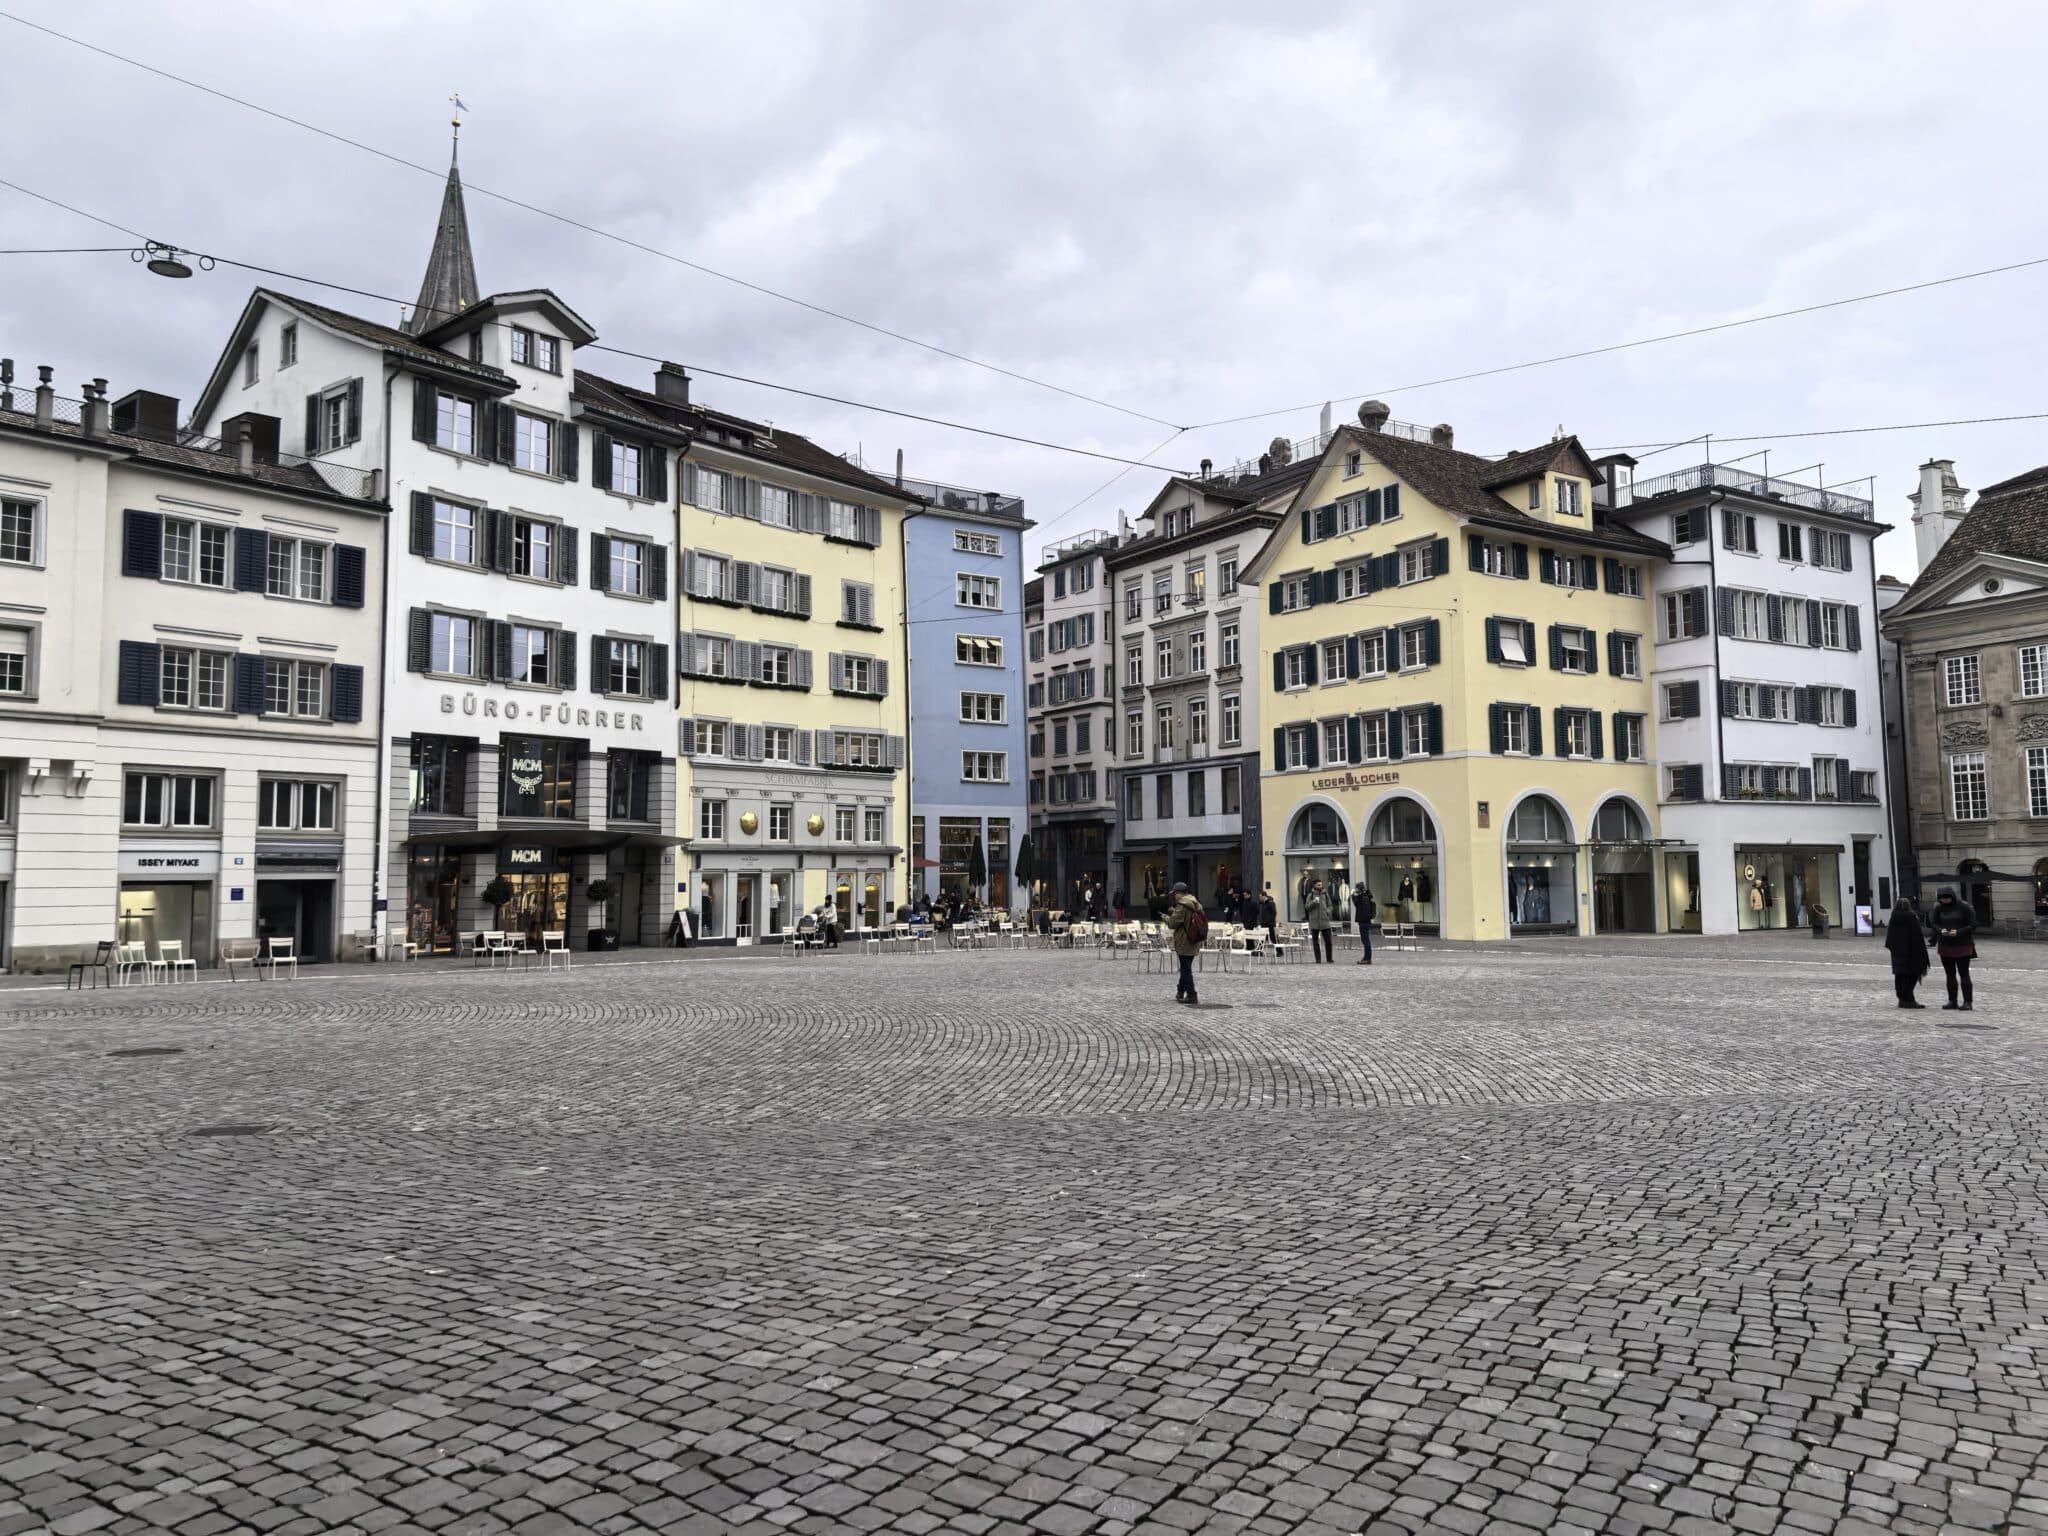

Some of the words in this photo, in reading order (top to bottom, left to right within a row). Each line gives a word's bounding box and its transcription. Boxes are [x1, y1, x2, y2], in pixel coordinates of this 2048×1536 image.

[512, 758, 543, 772] MCM
[1312, 777, 1345, 788] LEDER
[1354, 772, 1400, 784] LOCHER
[138, 858, 164, 867] ISSEY
[166, 858, 199, 867] MIYAKE
[511, 850, 542, 863] MCM
